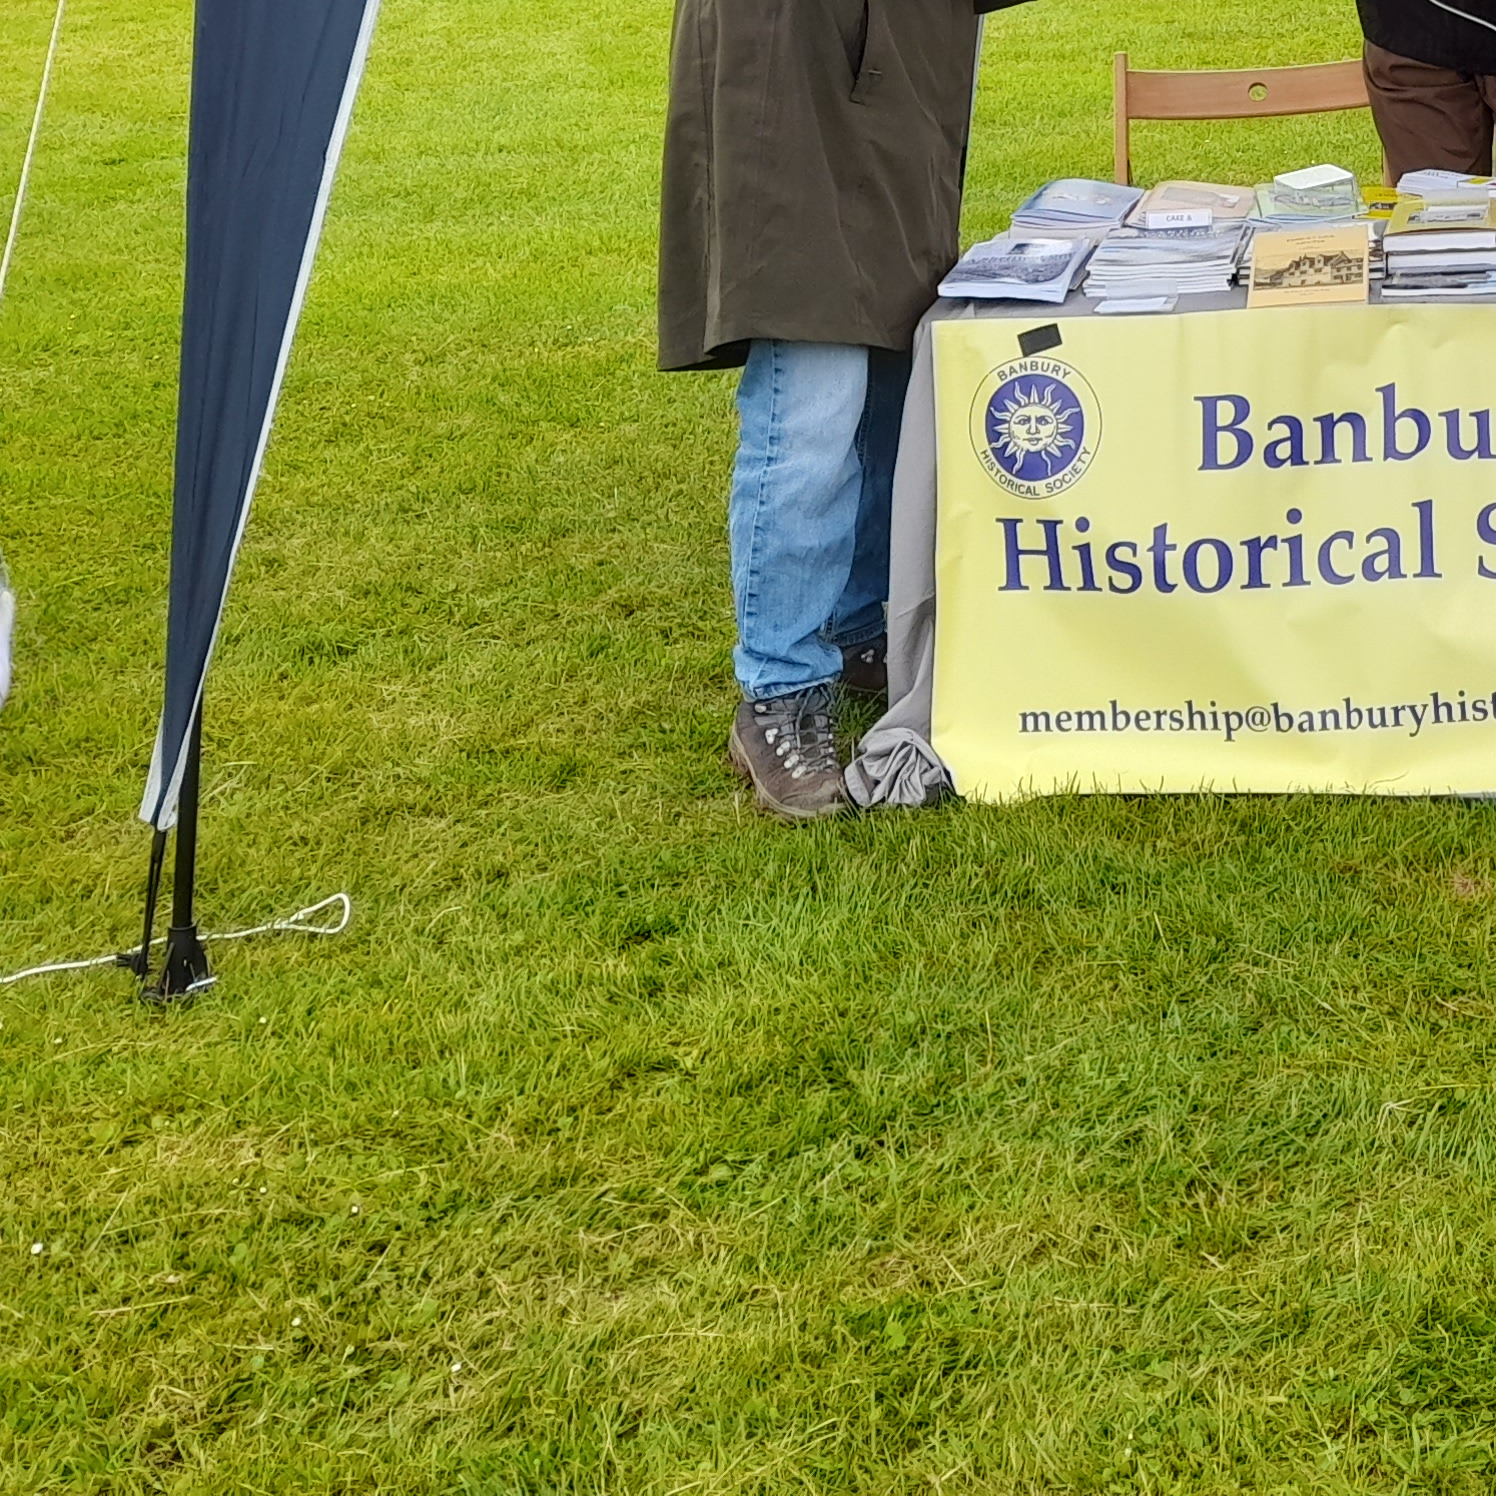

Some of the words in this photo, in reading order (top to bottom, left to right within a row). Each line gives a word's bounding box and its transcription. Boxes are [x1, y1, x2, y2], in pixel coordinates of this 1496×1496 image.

[997, 360, 1071, 382] BANBURY
[980, 449, 1040, 496] HISTORICAL
[1045, 446, 1091, 494] SOCIETY
[995, 499, 1442, 595] Historical
